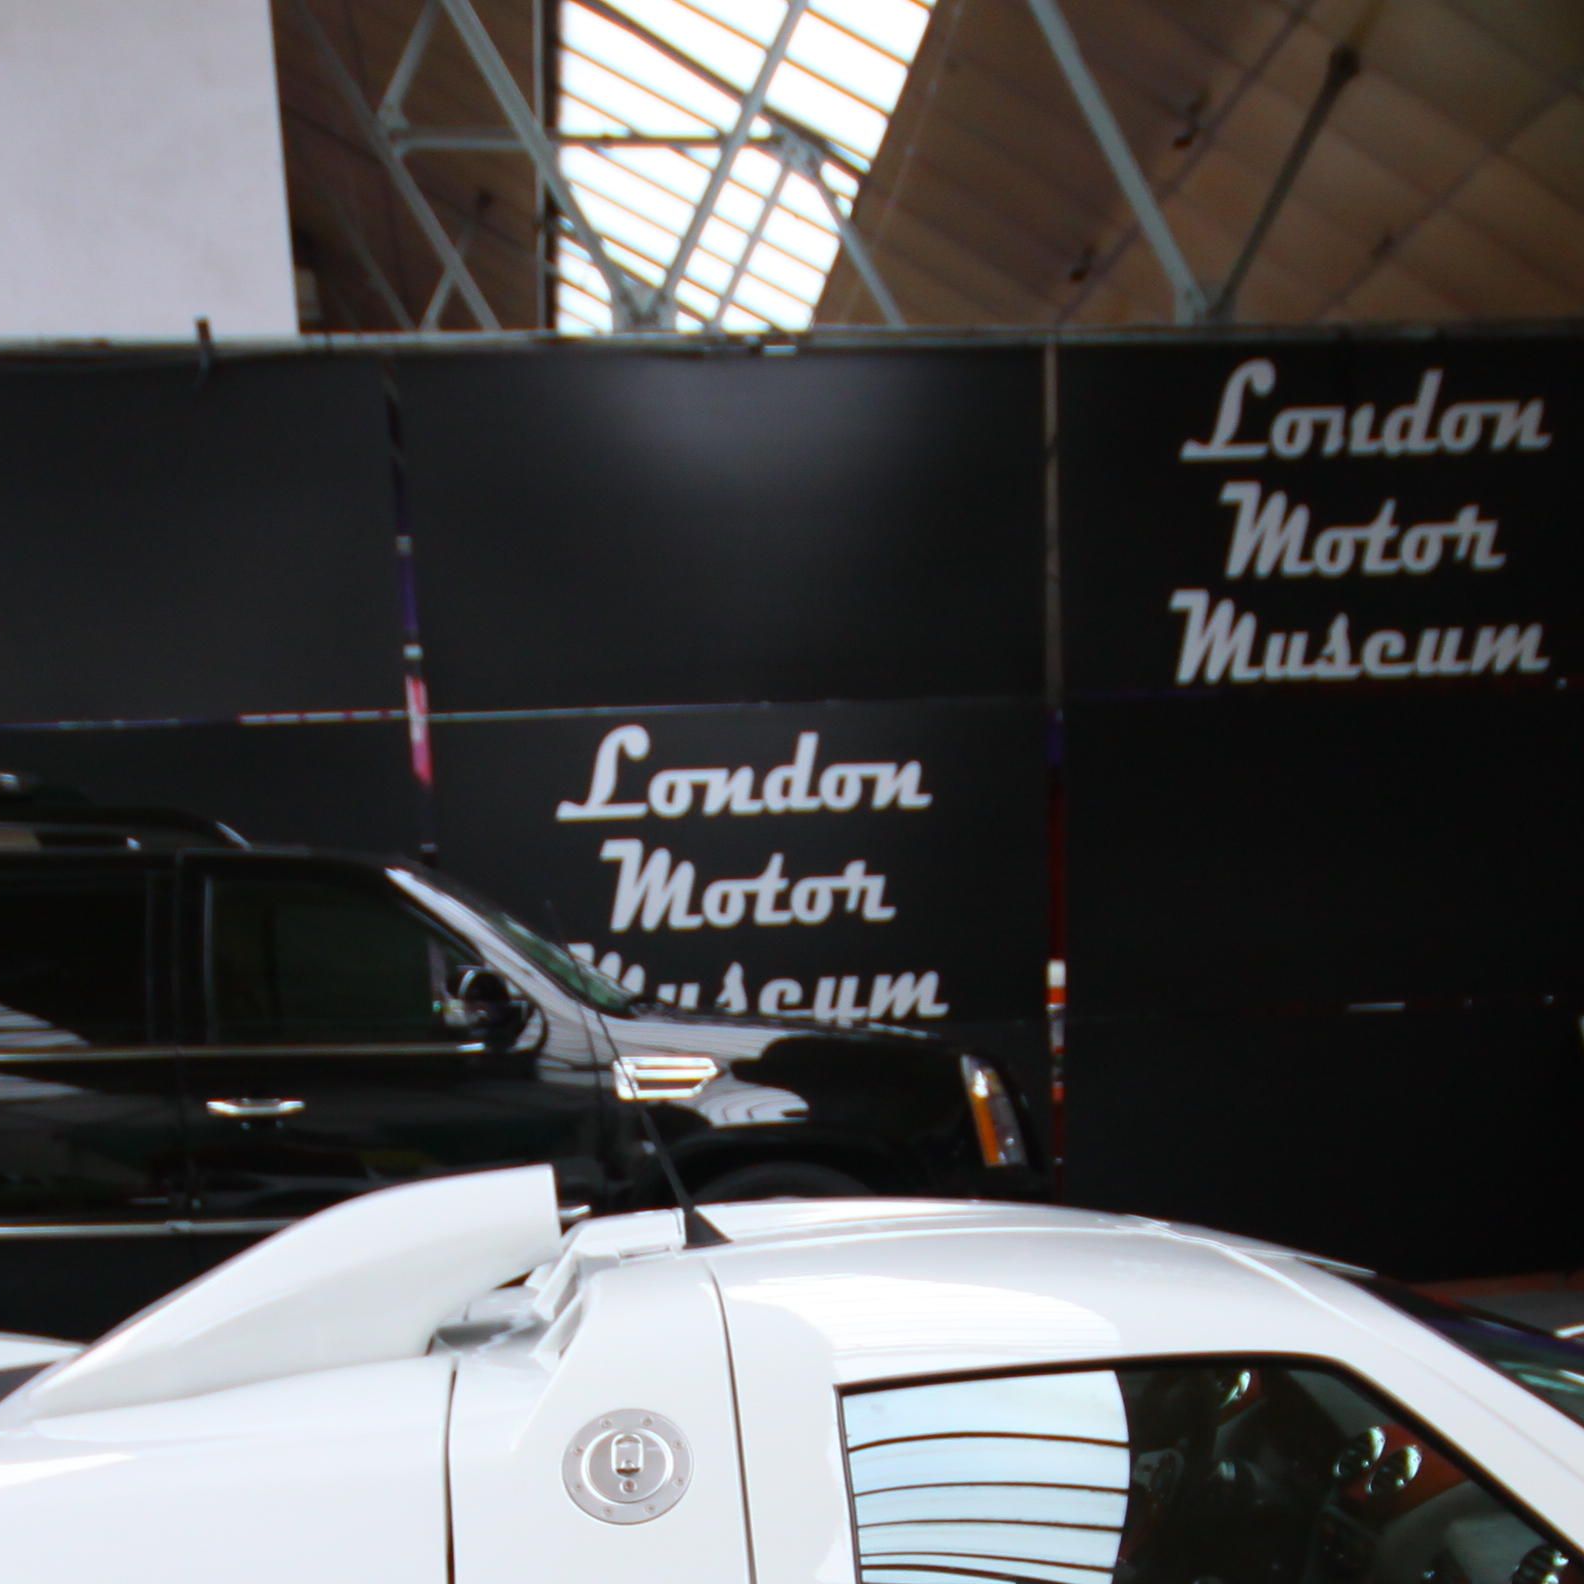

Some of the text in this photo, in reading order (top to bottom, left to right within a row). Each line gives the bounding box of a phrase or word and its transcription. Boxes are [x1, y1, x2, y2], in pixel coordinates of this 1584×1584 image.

[1180, 359, 1551, 461] London
[1220, 481, 1505, 578] Motor
[1169, 589, 1549, 684] Museum
[556, 724, 932, 821] London
[599, 838, 896, 932] Motor
